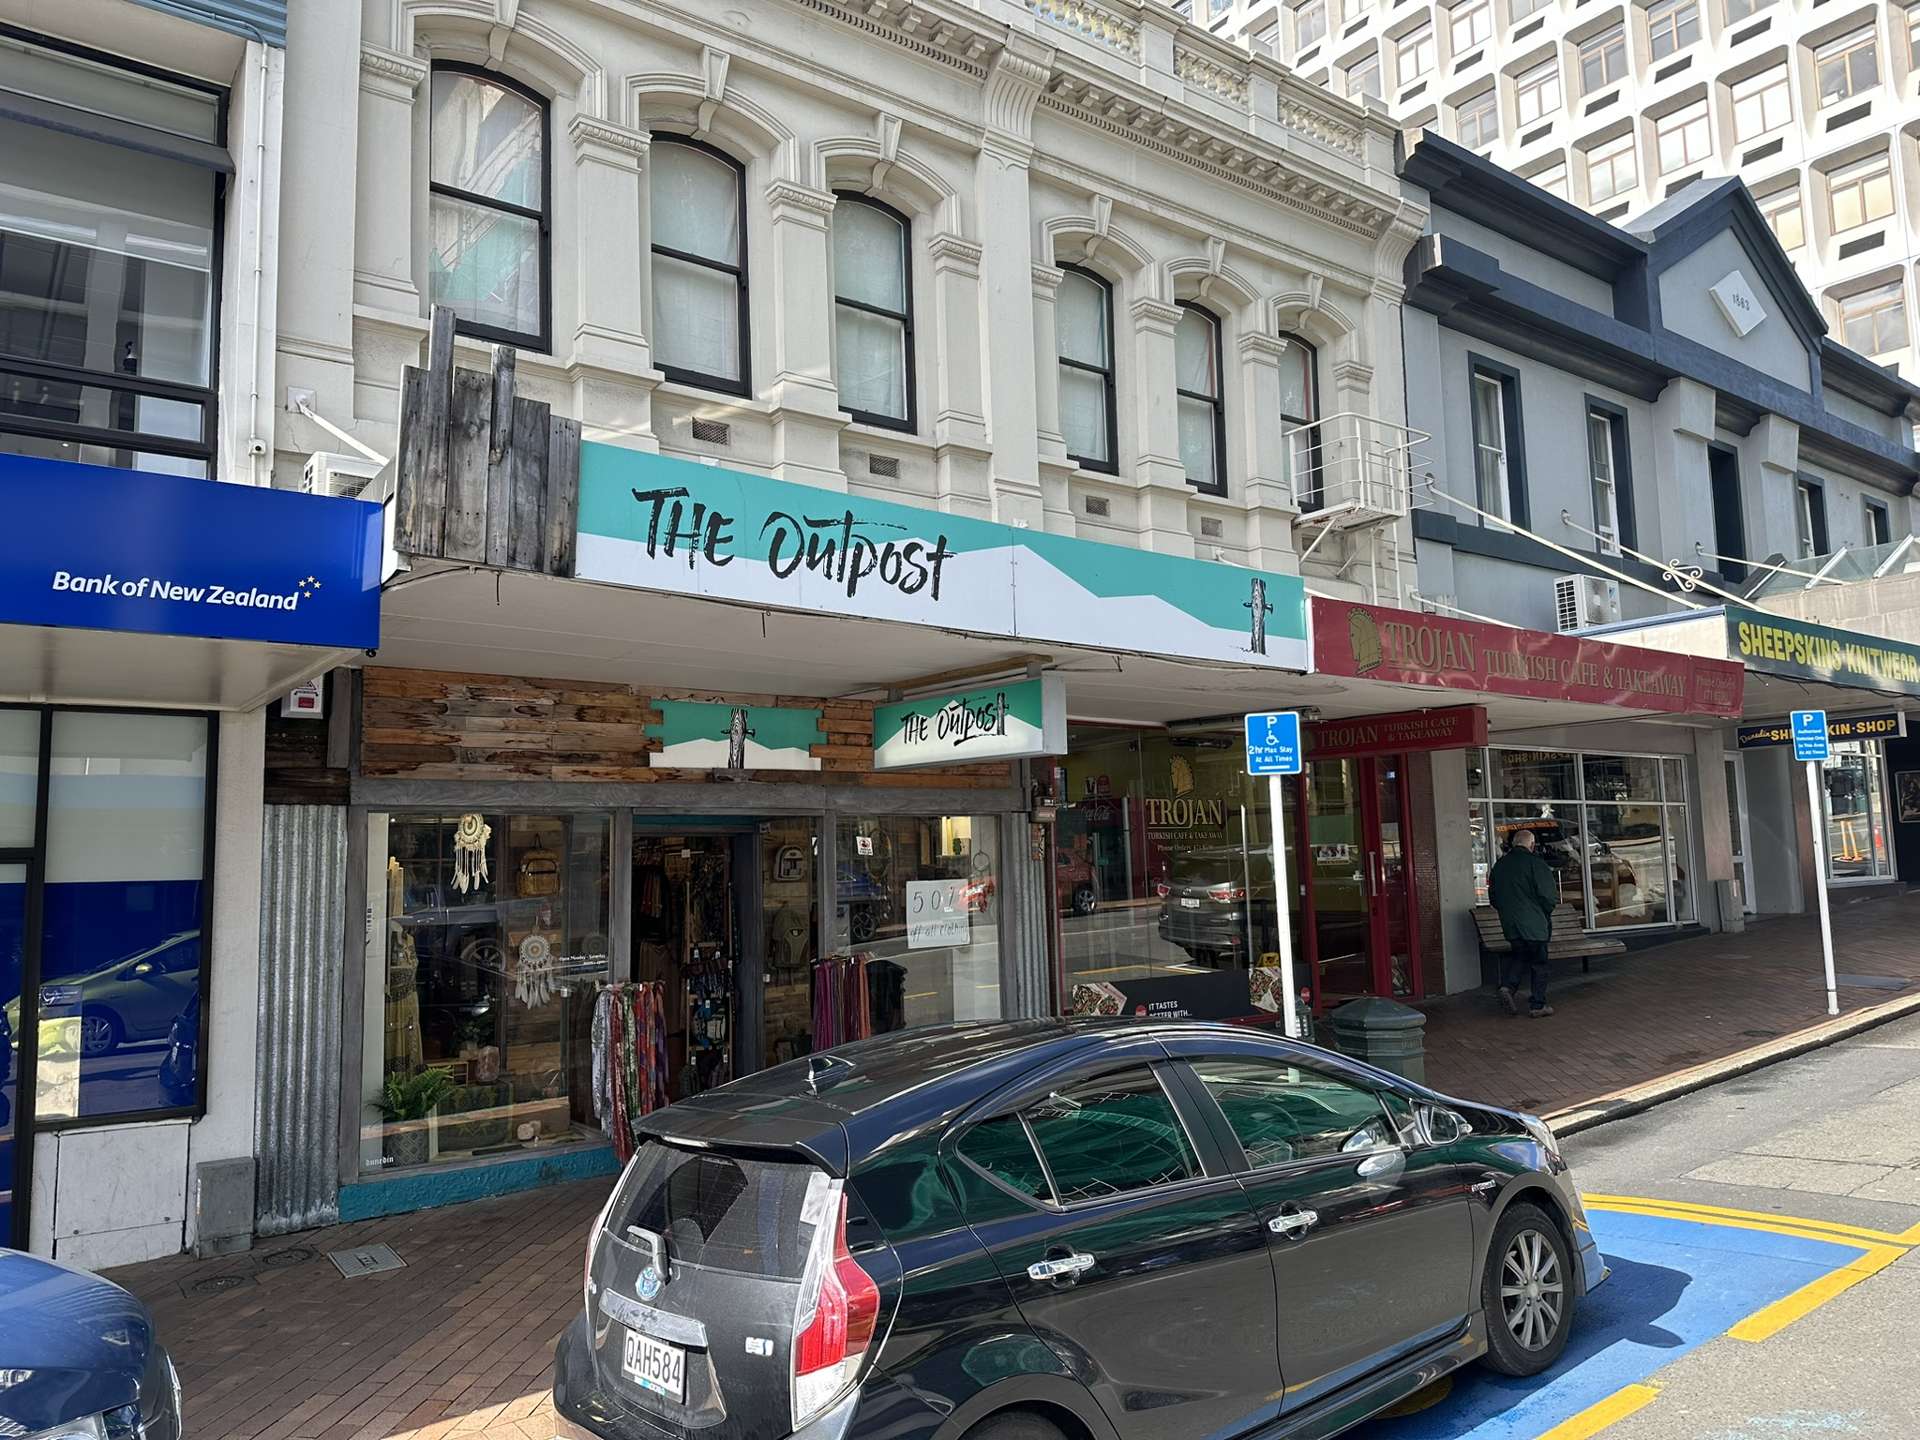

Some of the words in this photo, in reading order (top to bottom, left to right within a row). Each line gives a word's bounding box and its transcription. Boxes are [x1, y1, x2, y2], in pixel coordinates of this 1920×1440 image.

[632, 487, 734, 569] THE
[759, 510, 958, 601] Outpost
[52, 571, 119, 595] Bank
[121, 578, 149, 597] of
[150, 580, 205, 602] New
[206, 585, 299, 611] Zealand
[1384, 622, 1478, 673] TROJAN
[1483, 649, 1558, 681] TURKISH
[1561, 659, 1599, 687] CAFE
[1603, 667, 1613, 689] &
[1616, 667, 1687, 698] TAKEAWAY
[1738, 621, 1842, 672] SHEEPSKINS
[1846, 643, 1919, 683] KNITWEAR
[901, 711, 929, 744] THE
[936, 692, 1009, 746] Outpost
[1267, 716, 1278, 729] P
[1320, 725, 1378, 748] TROJAN
[1802, 714, 1814, 727] P
[1856, 719, 1896, 734] SHOP
[1145, 798, 1222, 829] TROJAN
[1155, 1000, 1178, 1009] TASTES
[626, 1336, 682, 1388] QAH584
